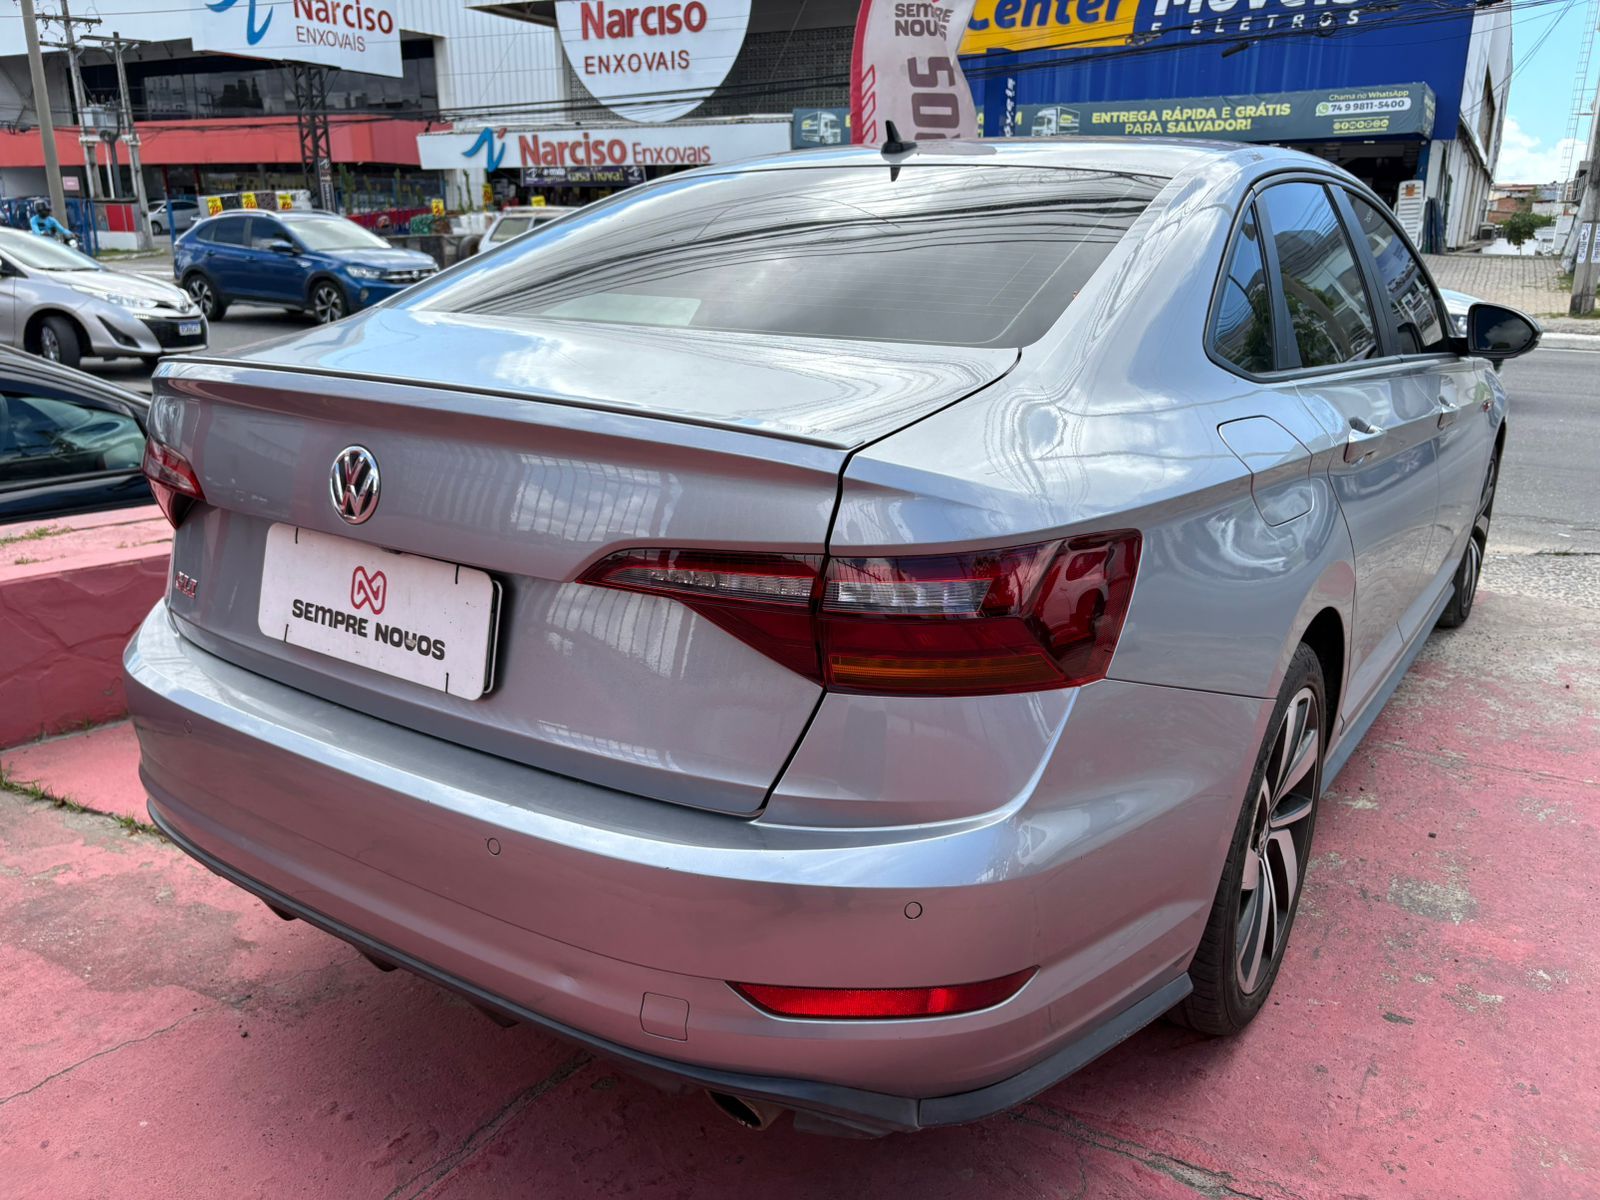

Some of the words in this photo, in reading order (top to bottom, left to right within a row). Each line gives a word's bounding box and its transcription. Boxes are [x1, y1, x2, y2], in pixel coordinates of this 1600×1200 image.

[580, 1, 708, 41] Narciso
[296, 25, 366, 52] ENXOVAIS
[584, 49, 691, 75] ENXOVAIS
[1368, 90, 1409, 99] WhatsApp
[1091, 109, 1159, 124] ENTREGA
[1161, 106, 1218, 121] RÁPIDA
[1221, 107, 1231, 118] E
[1235, 102, 1292, 118] GRÁTIS
[1331, 104, 1343, 112] 74
[1344, 104, 1351, 112] 9
[1124, 123, 1163, 134] PARA
[1167, 118, 1252, 134] SALVADOR!
[518, 132, 628, 167] Narciso
[632, 143, 712, 165] Enxovais
[292, 599, 369, 638] SEMPRE
